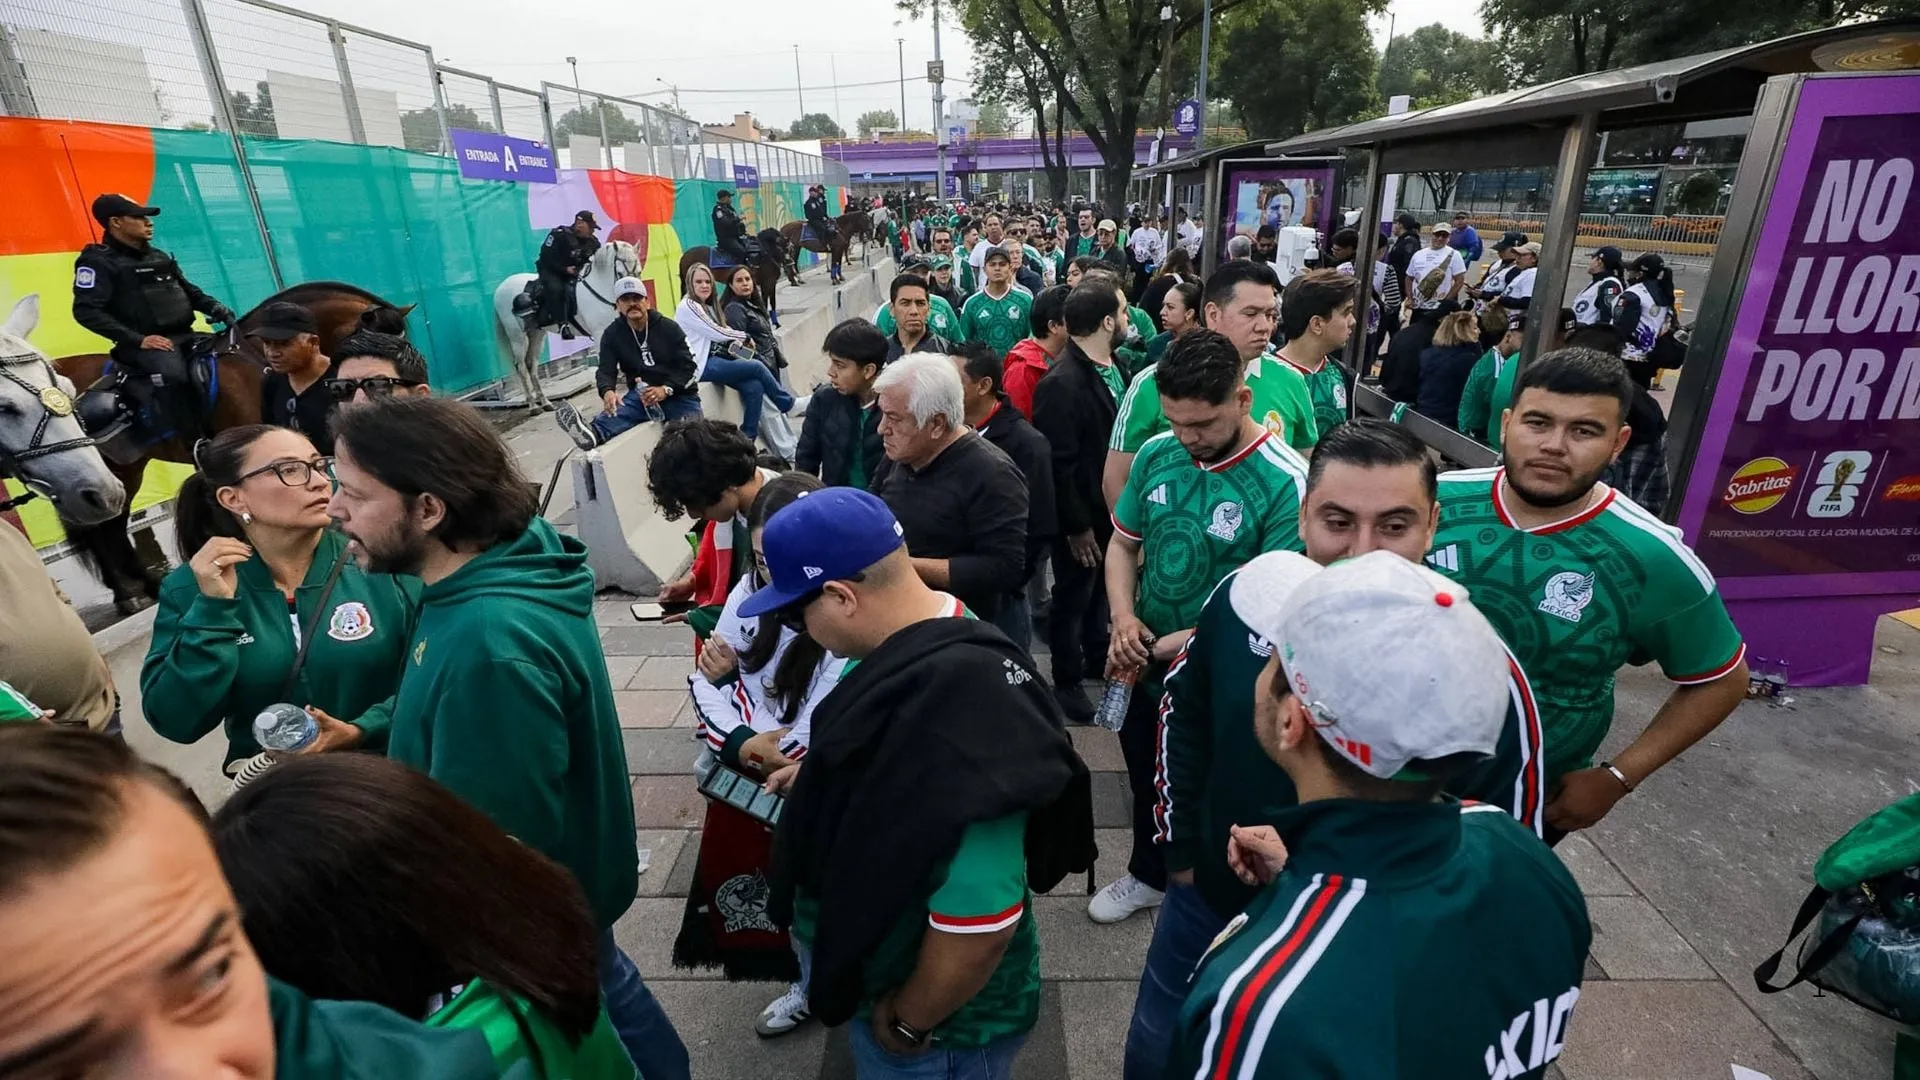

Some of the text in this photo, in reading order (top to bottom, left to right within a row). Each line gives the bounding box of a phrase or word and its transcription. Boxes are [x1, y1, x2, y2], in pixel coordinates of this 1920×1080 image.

[465, 146, 548, 172] ENTRADA A ENTRANCE
[1803, 157, 1915, 244] NO
[1774, 254, 1920, 335] LLOR
[1746, 347, 1886, 422] POR
[1724, 475, 1792, 501] Sabritas
[1819, 503, 1842, 512] FIFA
[1709, 529, 1775, 538] PATROCINADOR
[1775, 529, 1806, 537] OFICIAL
[1807, 528, 1820, 537] DE
[1820, 528, 1833, 537] LA
[1834, 528, 1858, 537] COPA
[1859, 527, 1898, 536] MUNDIAL
[1540, 603, 1579, 620] MEXICO
